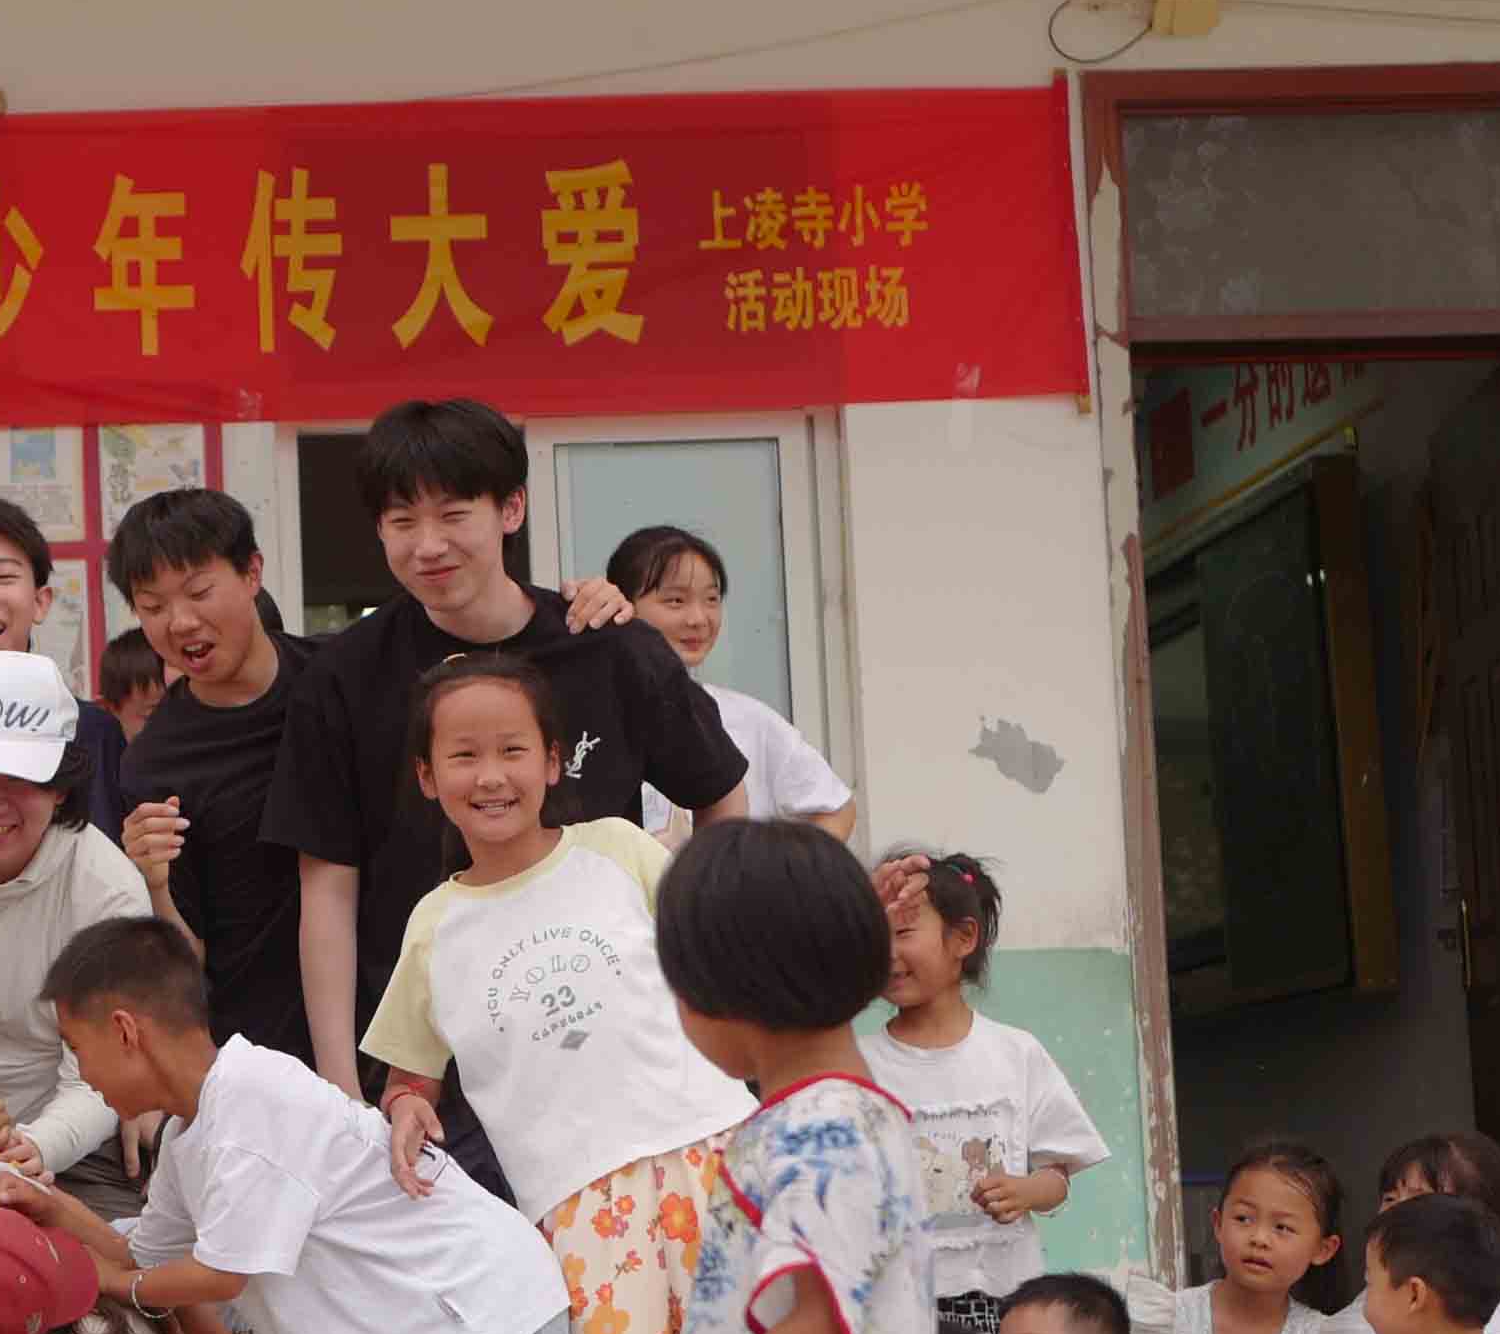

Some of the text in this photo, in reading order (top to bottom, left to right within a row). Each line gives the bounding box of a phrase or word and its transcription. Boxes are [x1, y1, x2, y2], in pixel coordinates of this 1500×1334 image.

[698, 182, 929, 250] 上凌寺小学
[725, 265, 910, 332] 活动现场
[491, 938, 526, 980] ONLY
[532, 926, 574, 945] LIVE
[578, 928, 622, 967] ONCE
[540, 984, 577, 1018] 23
